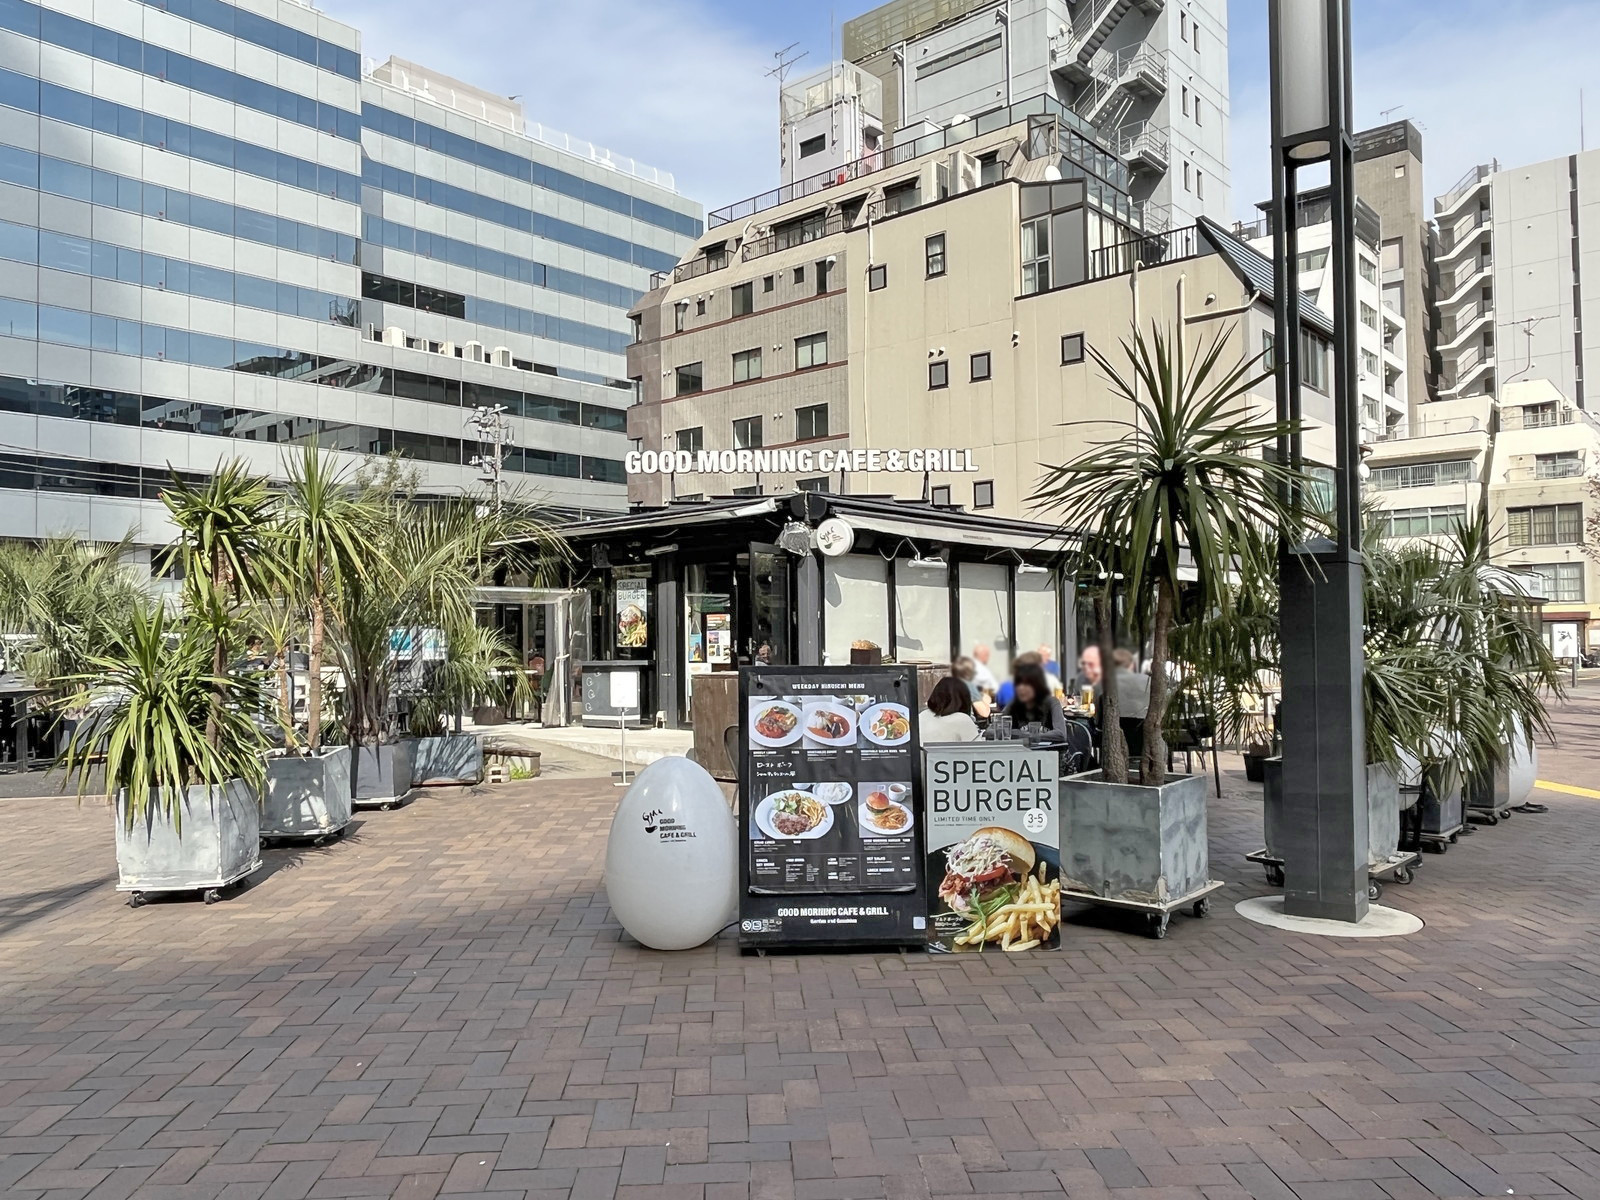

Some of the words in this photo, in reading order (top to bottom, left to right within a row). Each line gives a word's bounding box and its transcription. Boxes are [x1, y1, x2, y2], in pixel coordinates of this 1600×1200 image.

[624, 450, 693, 474] GOOD
[697, 450, 814, 474] MORNING
[818, 449, 882, 473] CAFE
[885, 449, 905, 473] &
[907, 449, 980, 472] GRILL
[617, 591, 646, 601] BURGER
[933, 759, 1053, 784] SPECIAL
[933, 788, 1053, 812] BURGER
[1027, 813, 1044, 824] 3-5
[777, 908, 799, 917] GOOD
[800, 907, 837, 917] MORNING
[838, 907, 858, 916] CAFE
[858, 907, 866, 916] &
[866, 906, 889, 916] GRILL
